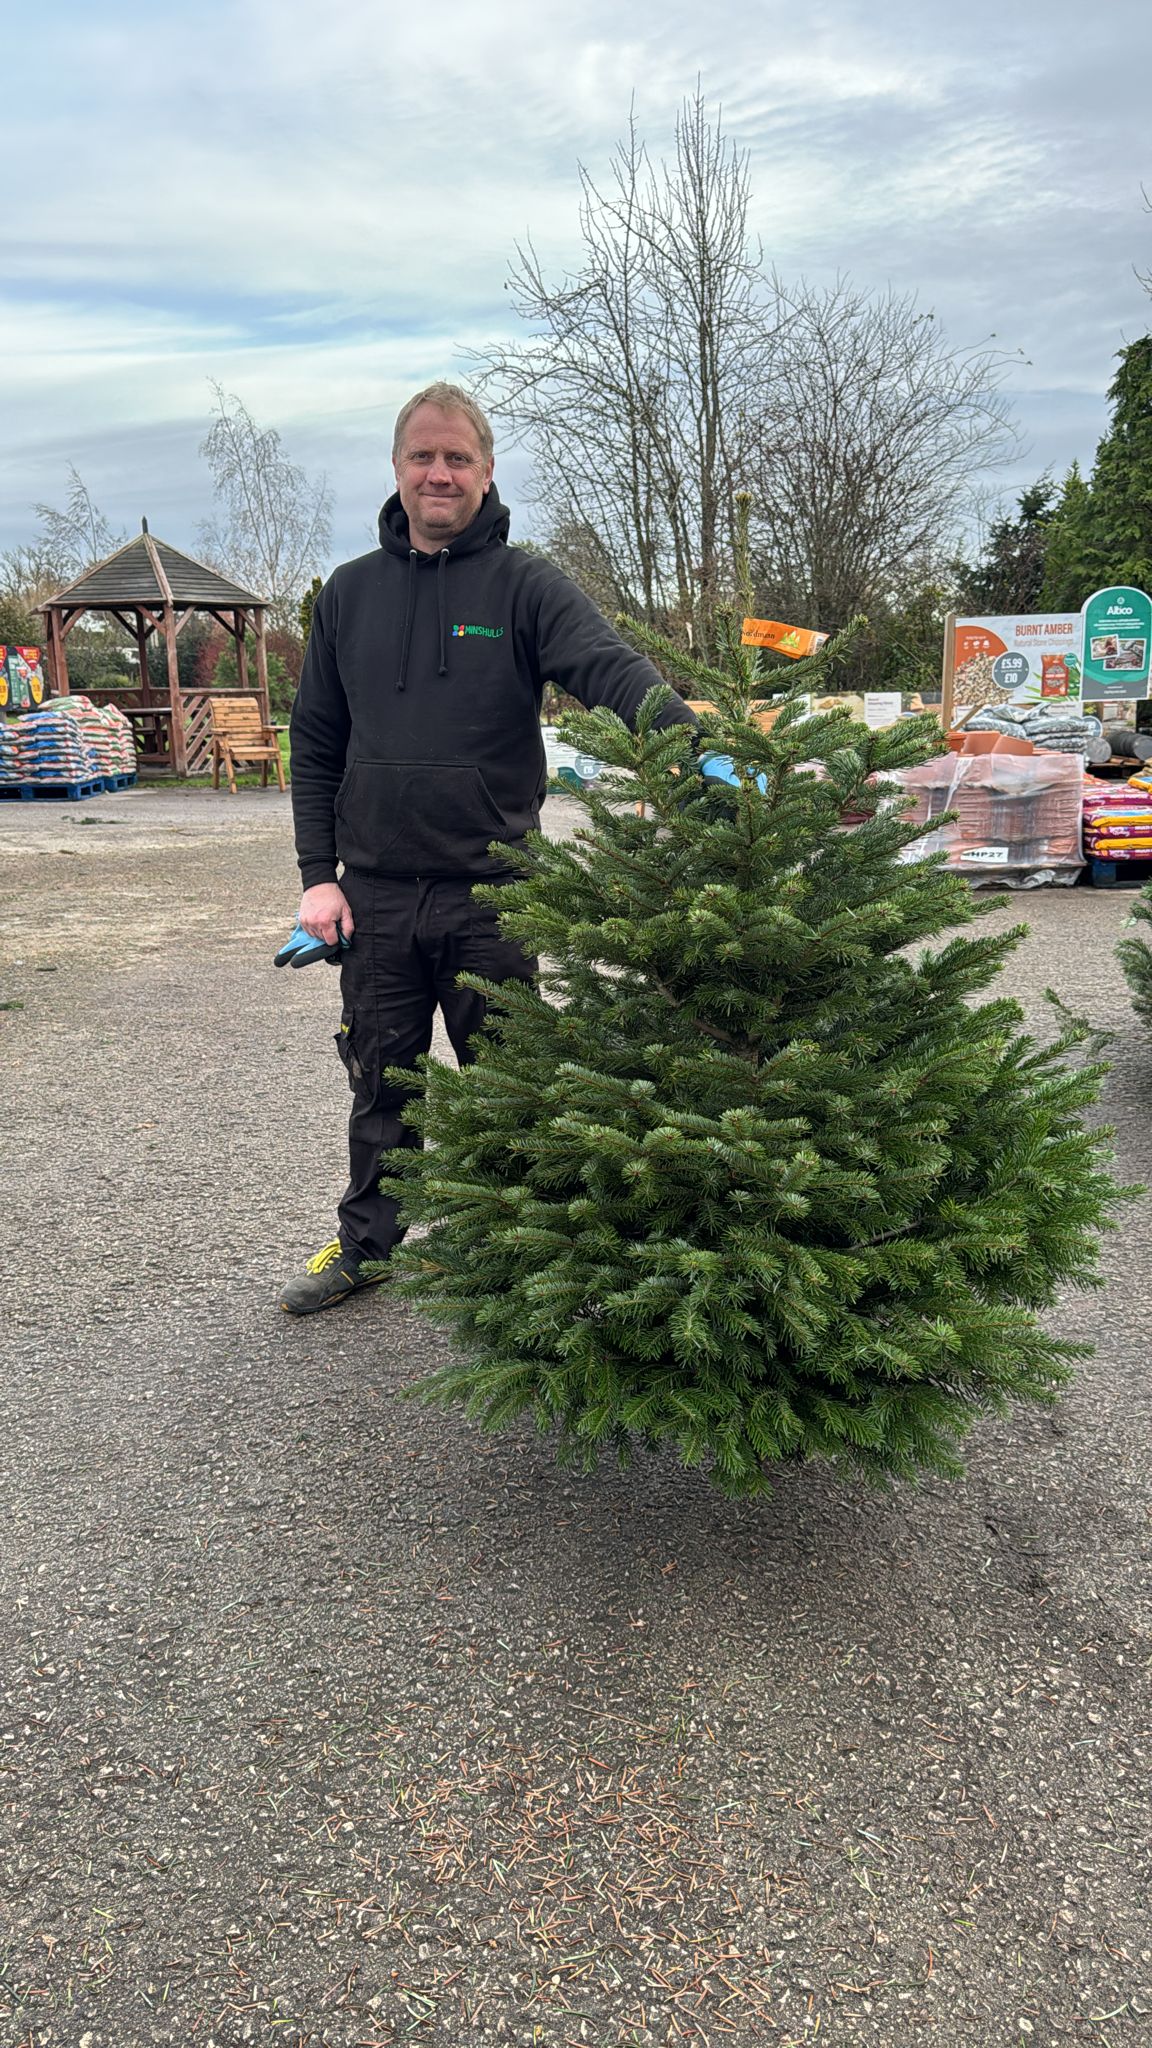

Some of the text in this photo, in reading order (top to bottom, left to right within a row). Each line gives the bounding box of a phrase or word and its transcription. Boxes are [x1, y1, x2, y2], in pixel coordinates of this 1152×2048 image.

[1015, 623, 1073, 636] BURNT AMBER
[1001, 657, 1023, 669] £5.99
[1004, 672, 1018, 684] £10
